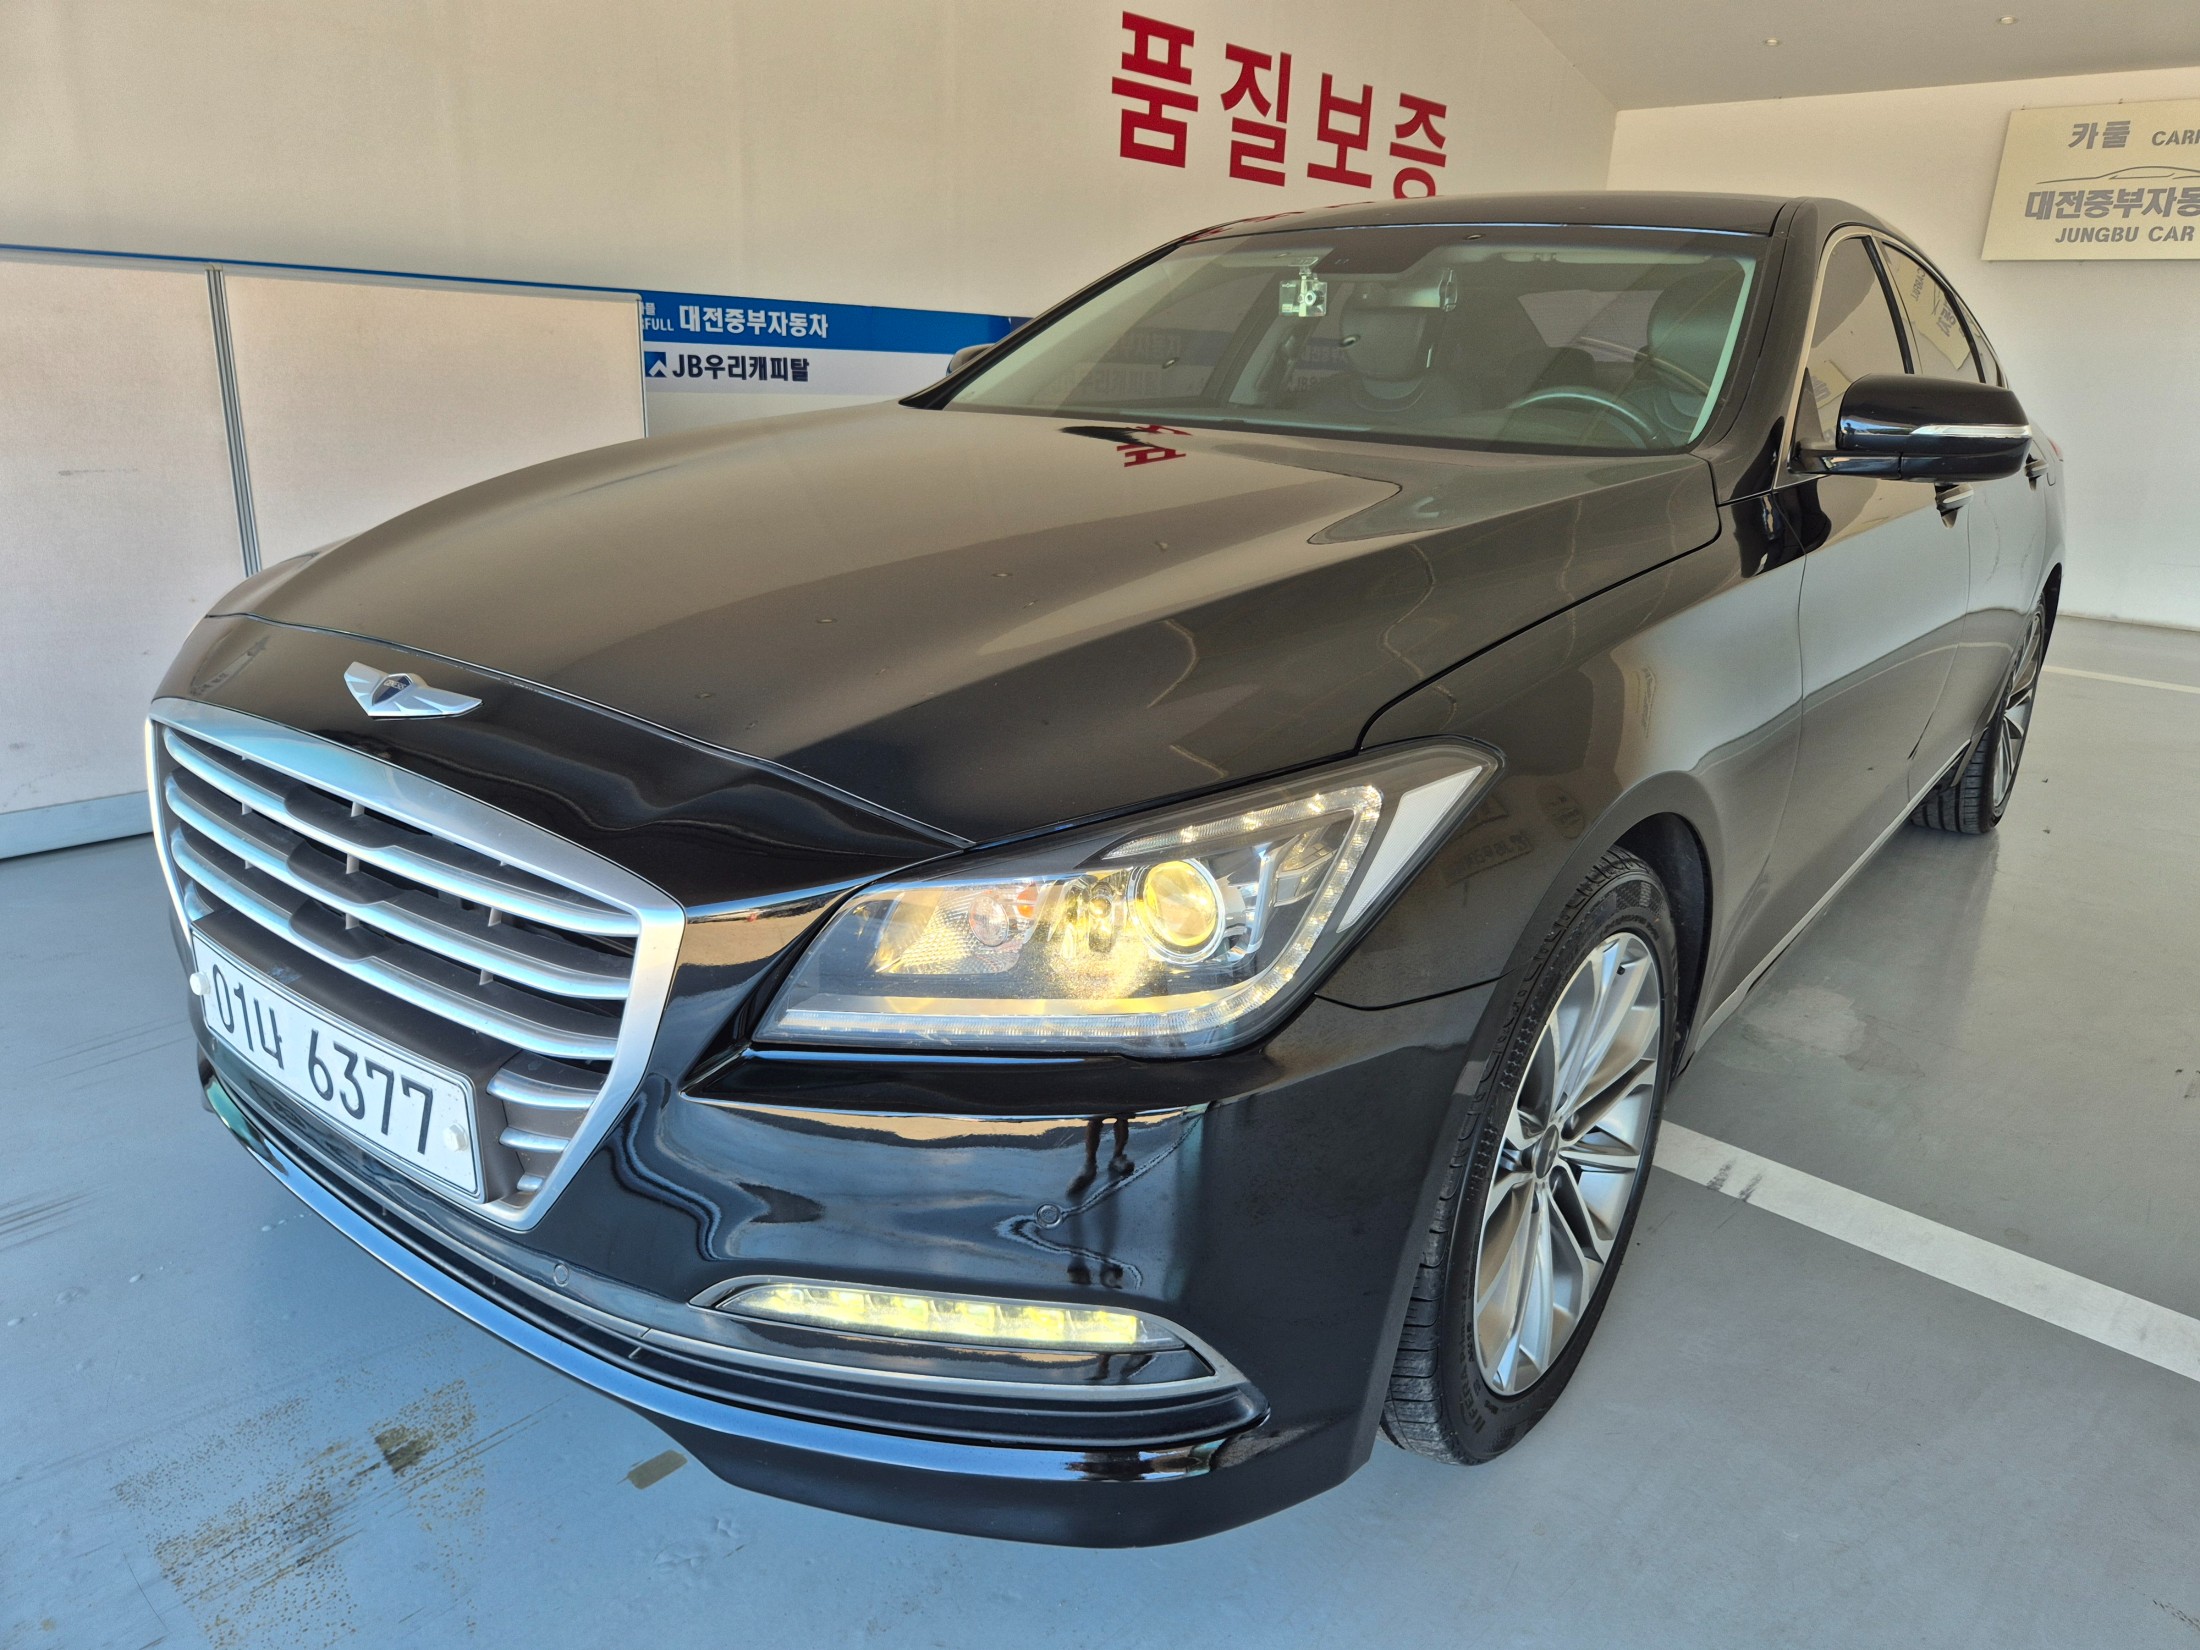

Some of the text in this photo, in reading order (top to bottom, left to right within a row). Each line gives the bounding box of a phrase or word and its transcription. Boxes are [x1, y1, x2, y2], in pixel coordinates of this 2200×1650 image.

[1111, 11, 1447, 200] 품질보증
[2024, 187, 2200, 220] 대전중부자동
[2055, 225, 2196, 243] JUNGBU CAR
[642, 317, 674, 331] FULL
[680, 305, 828, 338] 대전중부자동차
[672, 353, 810, 382] JB우리캐피탈
[212, 963, 434, 1155] 01나 6377
